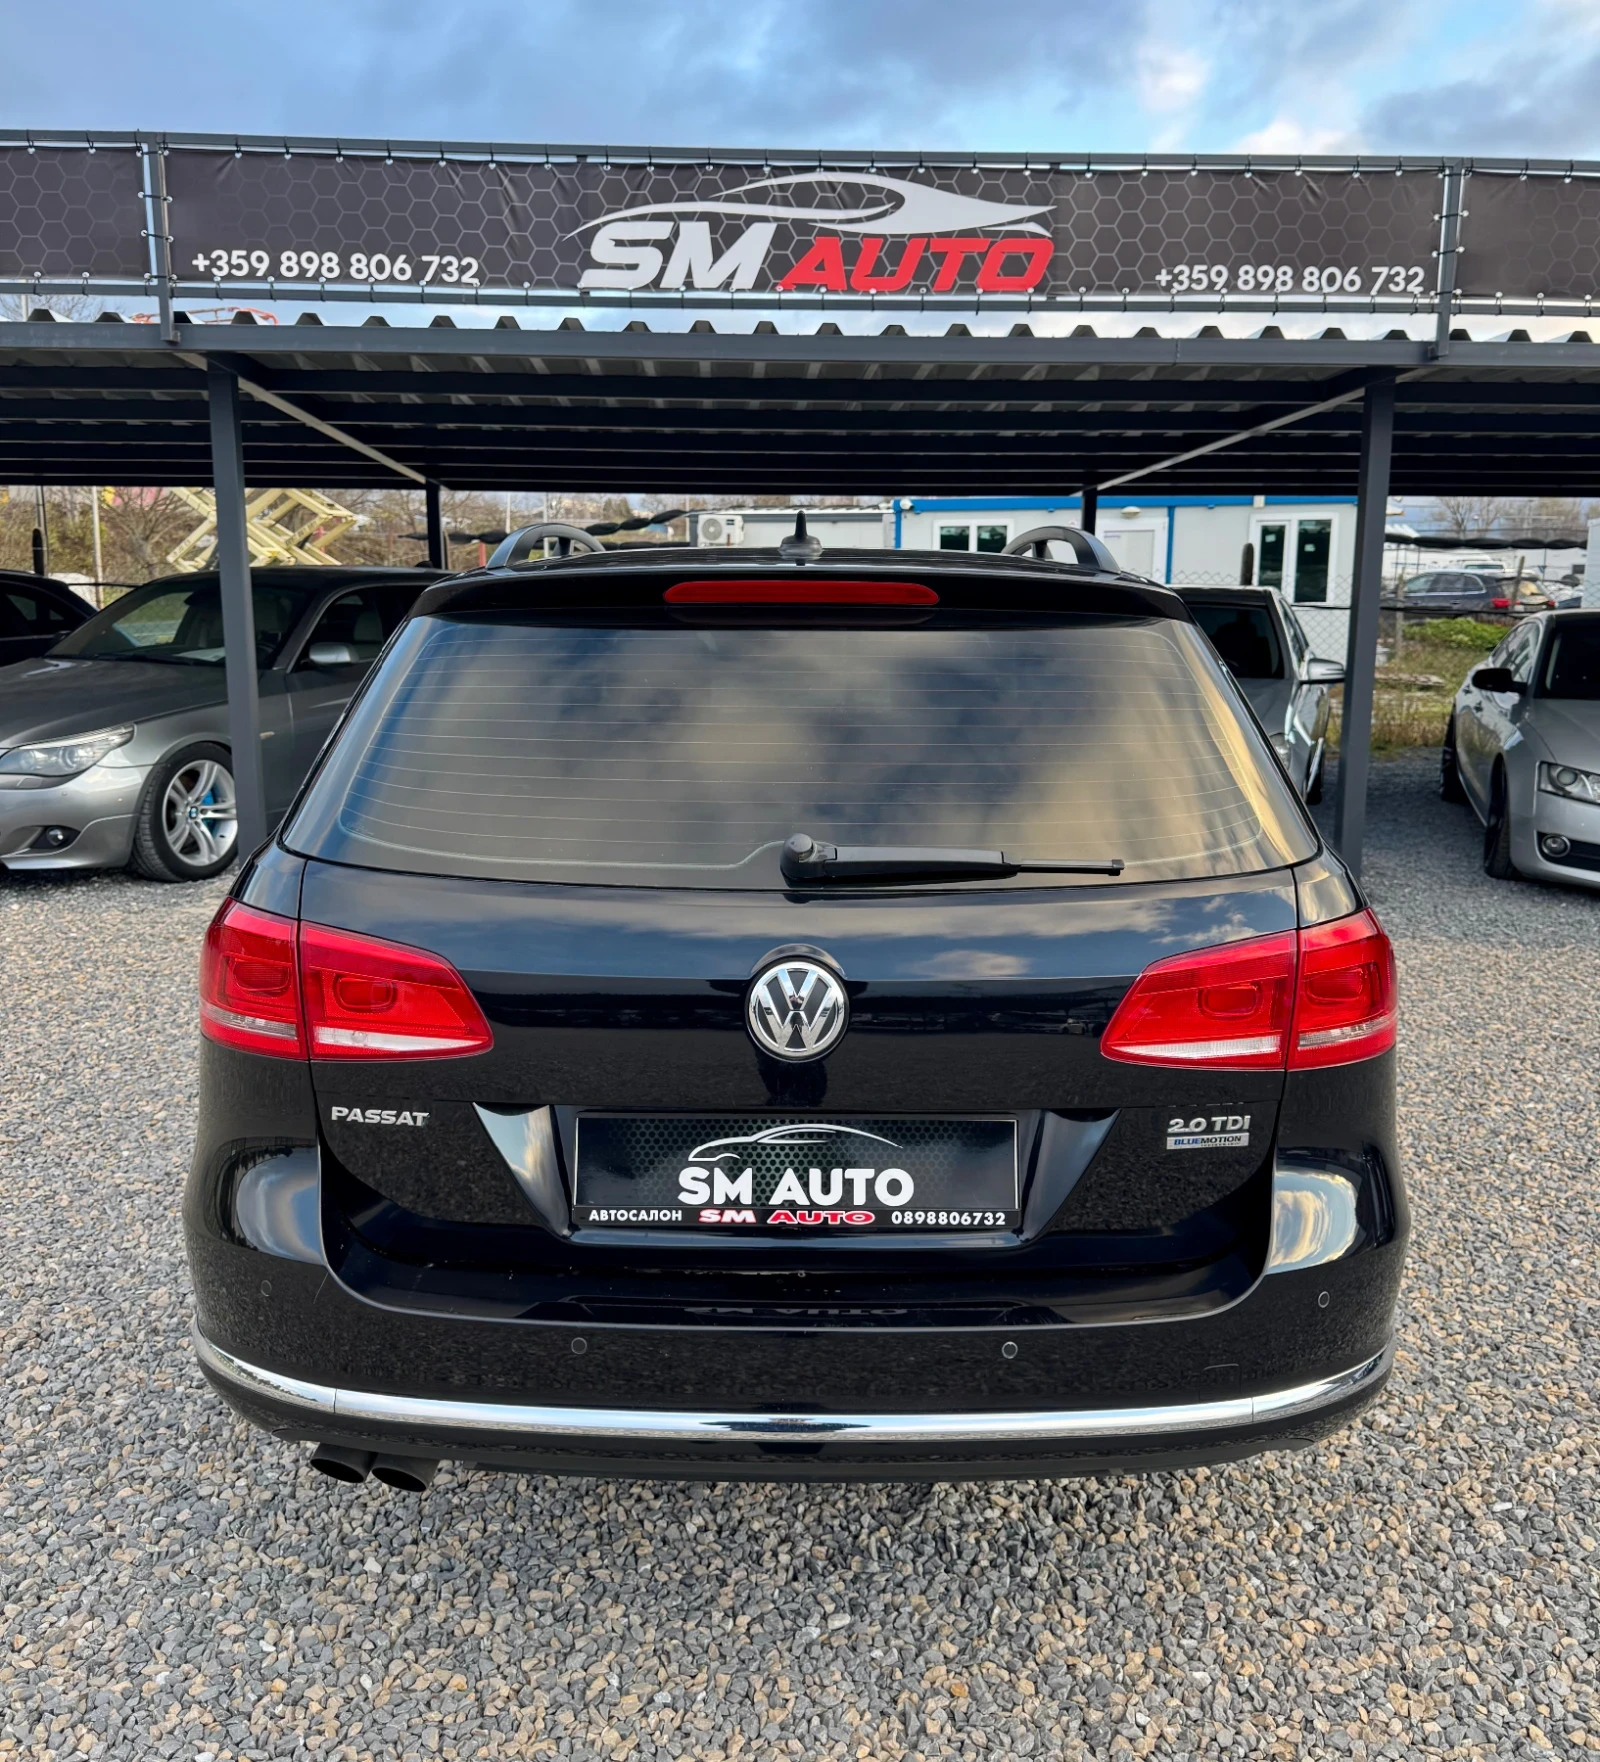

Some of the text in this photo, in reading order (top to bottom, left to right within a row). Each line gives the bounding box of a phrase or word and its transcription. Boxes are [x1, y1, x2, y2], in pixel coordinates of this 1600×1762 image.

[191, 249, 480, 284] +359 898 806 732
[580, 221, 1055, 291] SM AUTO
[1155, 264, 1425, 295] +359 898 806 732
[331, 1106, 430, 1126] PASSAT
[1167, 1115, 1251, 1133] 2.0 TDI
[677, 1166, 915, 1206] SM AUTO
[588, 1209, 1006, 1226] АВТОСАЛОН SM AUTO 0898806732
